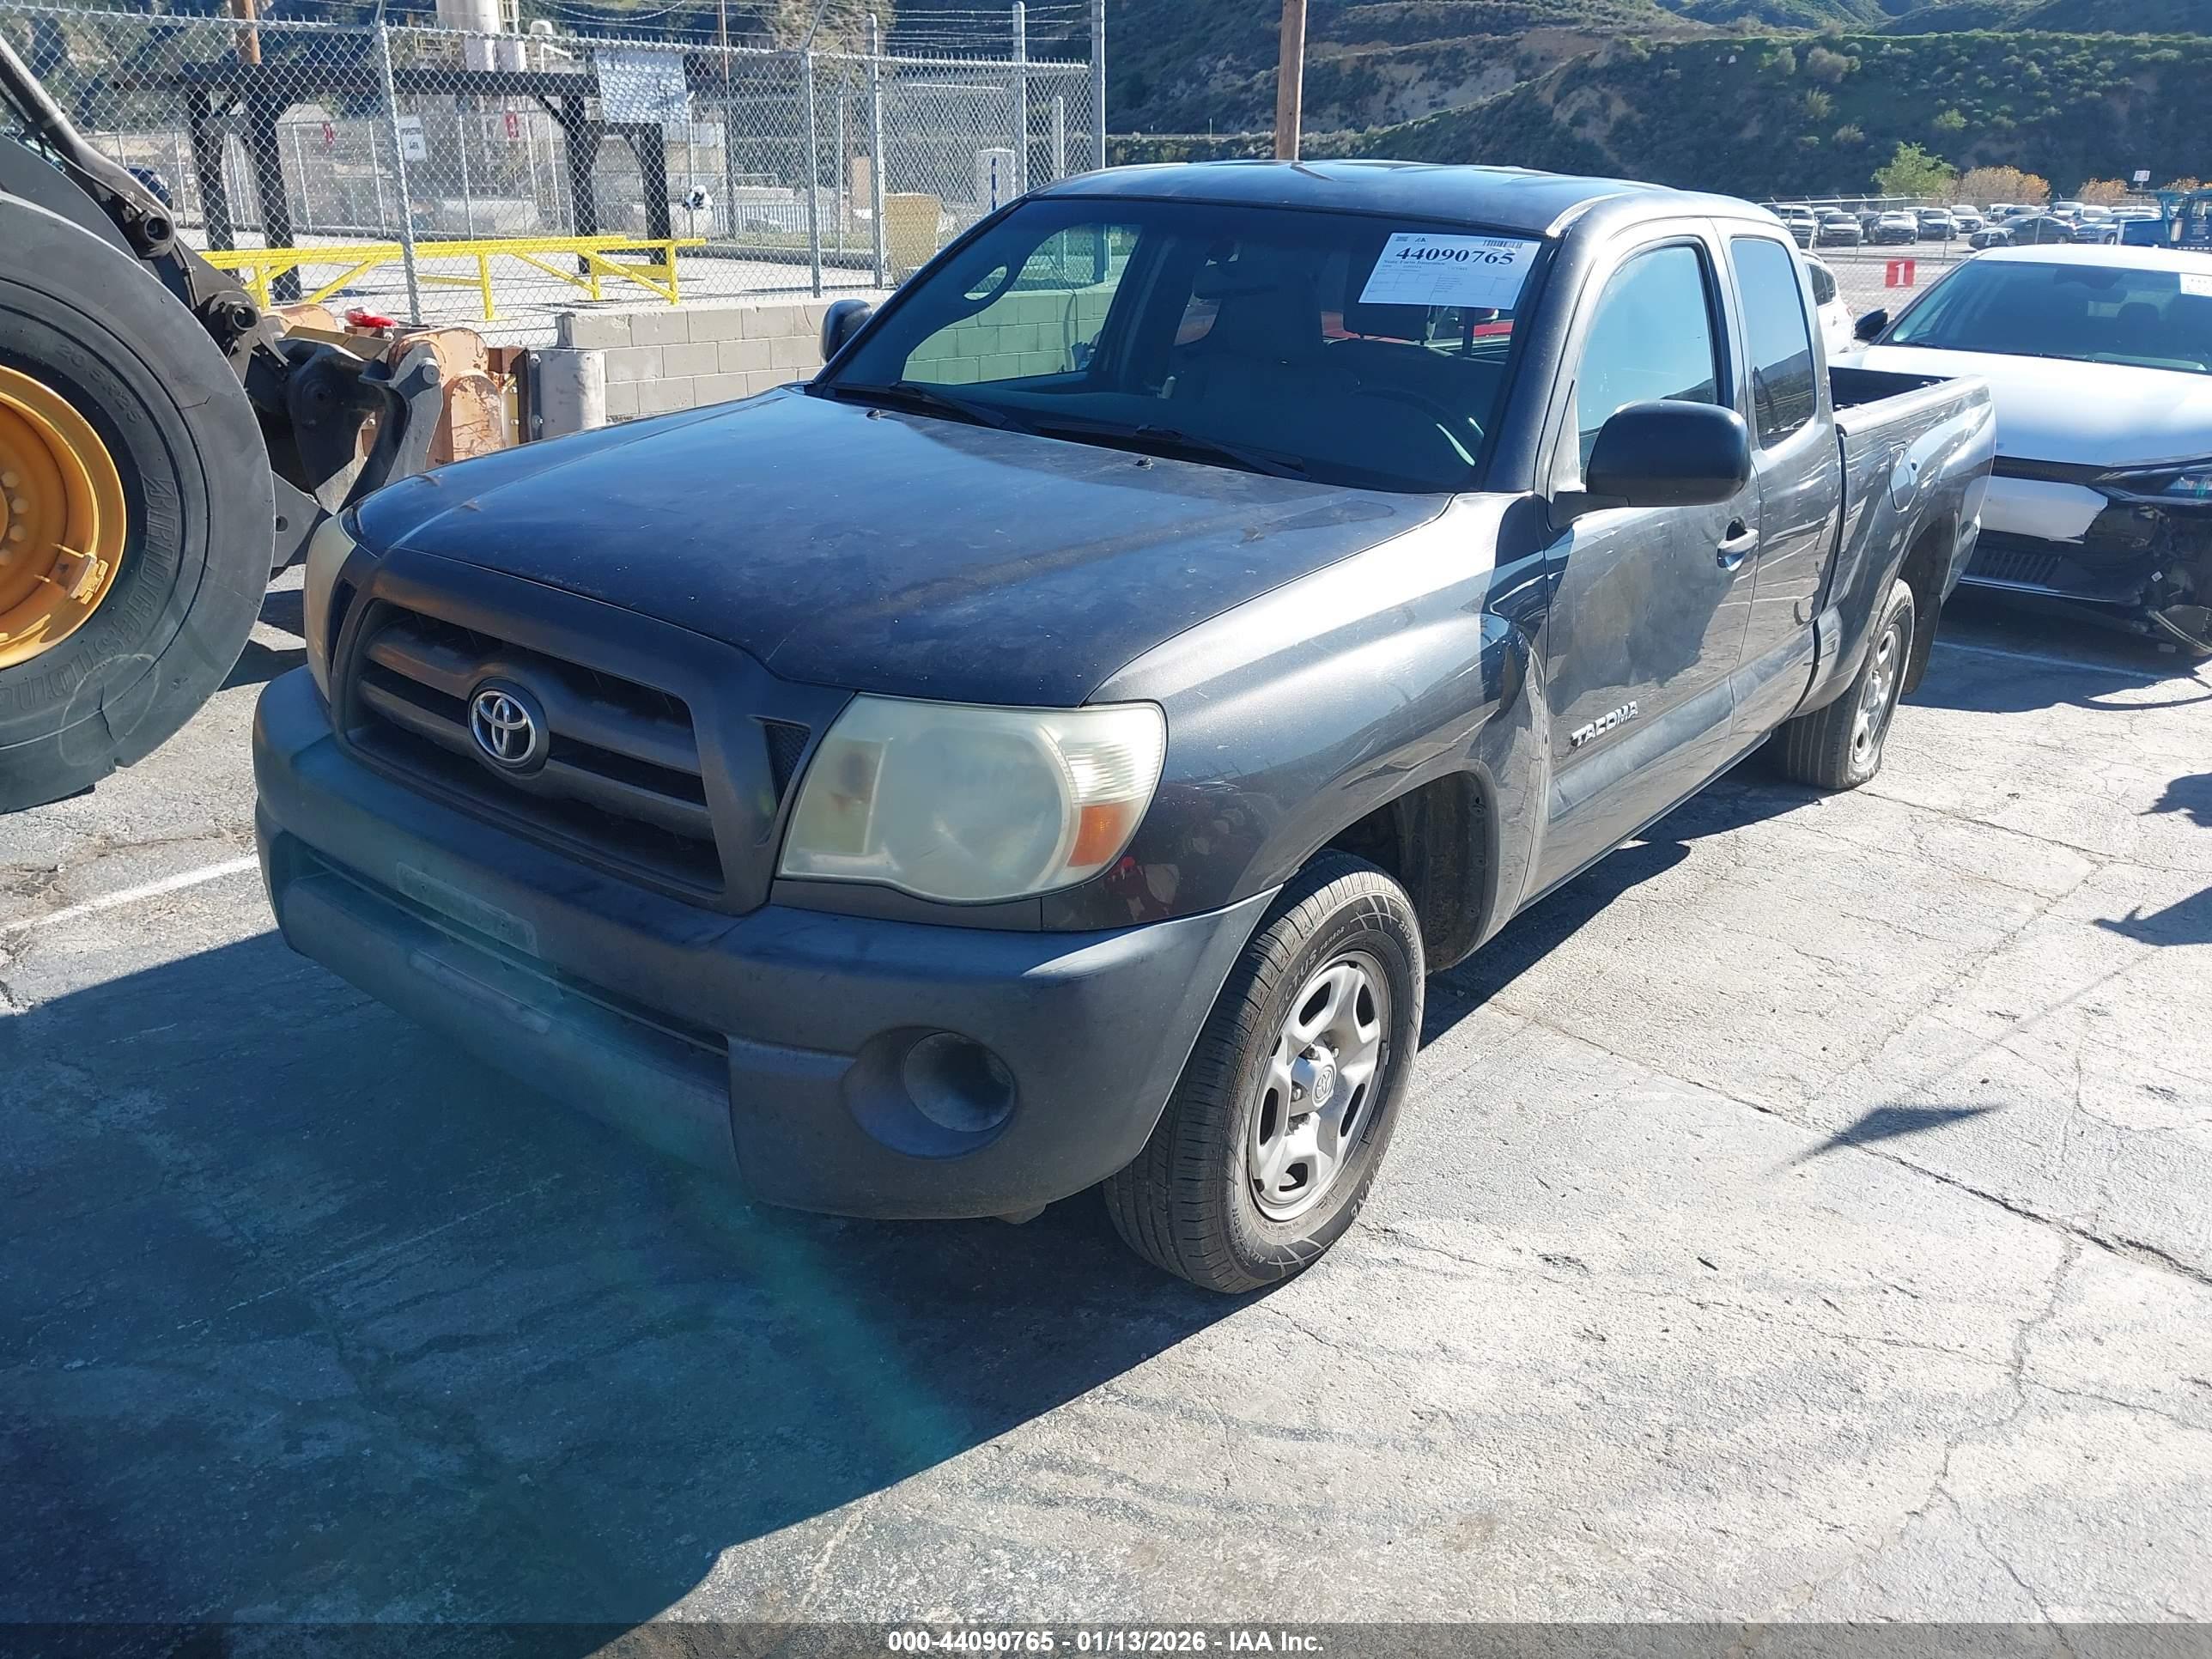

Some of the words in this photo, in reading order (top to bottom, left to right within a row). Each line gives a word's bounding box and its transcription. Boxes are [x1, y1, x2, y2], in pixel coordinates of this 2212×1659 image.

[1396, 246, 1516, 265] 44090765
[1894, 263, 1905, 286] 1
[1571, 700, 1639, 747] TACOMA
